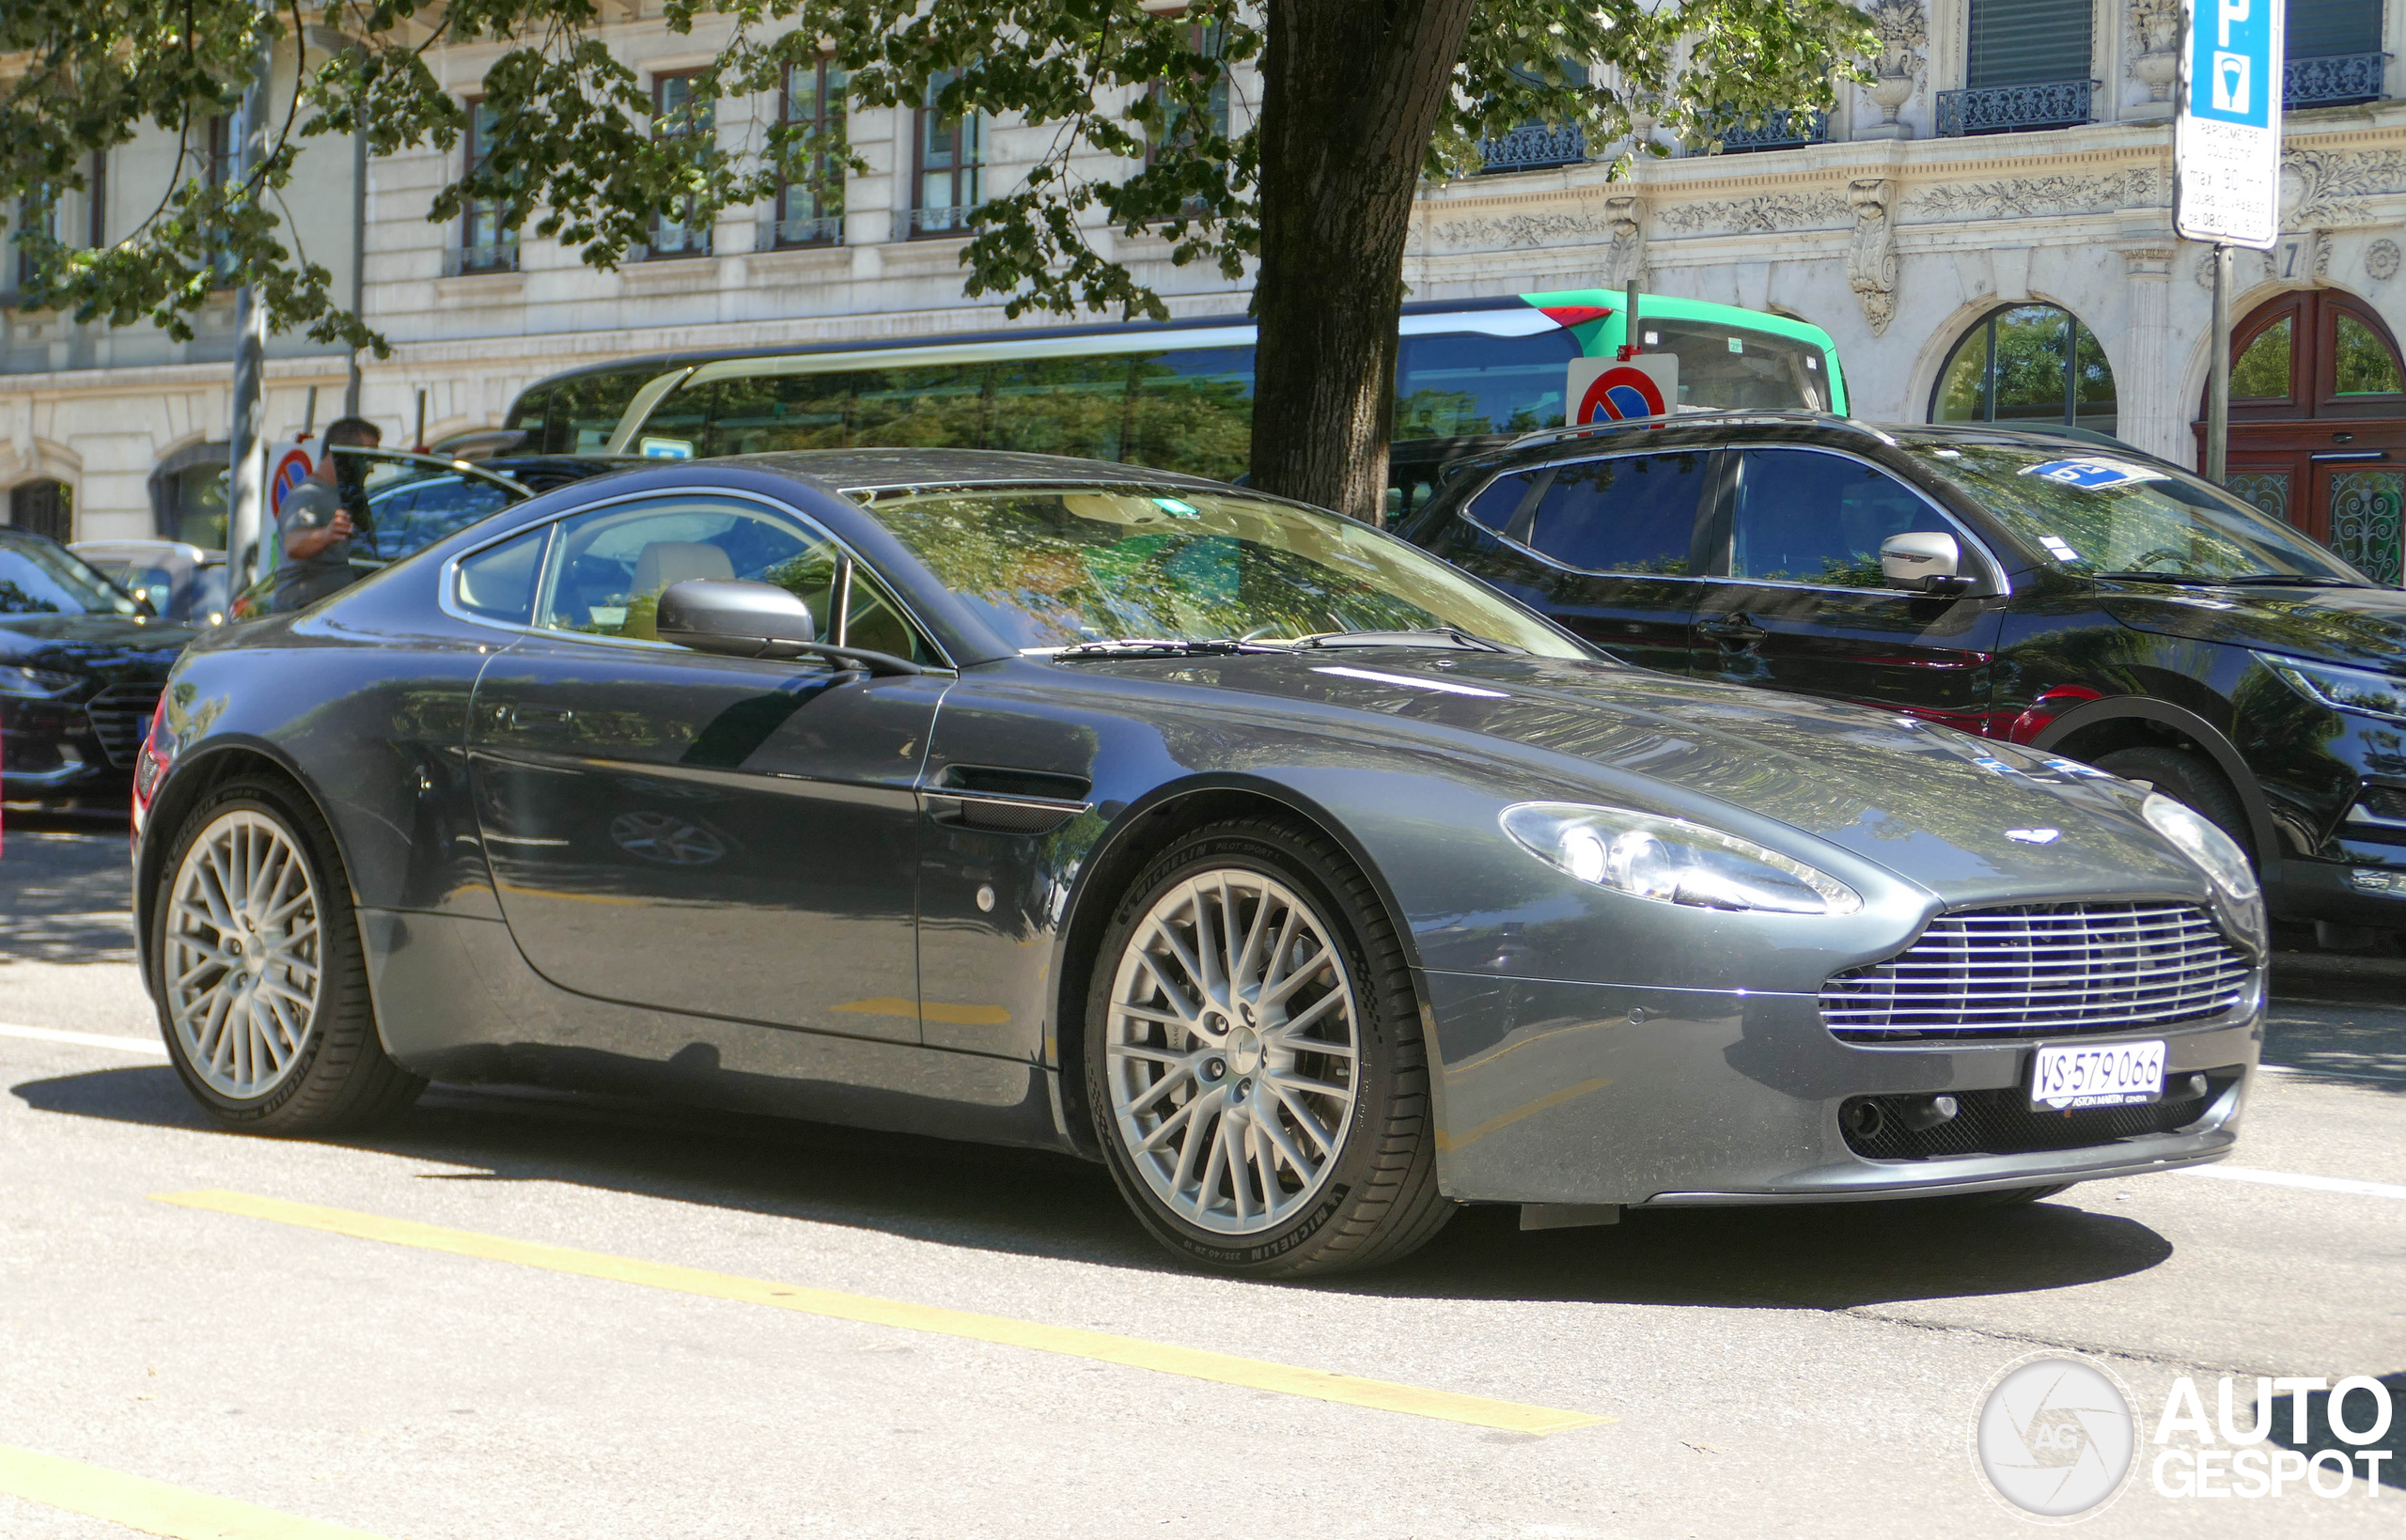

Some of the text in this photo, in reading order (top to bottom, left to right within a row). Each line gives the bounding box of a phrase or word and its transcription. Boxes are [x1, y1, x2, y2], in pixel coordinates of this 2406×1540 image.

[2218, 0, 2250, 47] P
[2207, 143, 2252, 162] COLLECTF
[2224, 167, 2239, 191] 90
[2190, 193, 2215, 207] JOURS
[1135, 843, 1207, 902] MICHELIN
[2072, 1096, 2096, 1107] ASTON
[2096, 1093, 2124, 1106] MARTIN
[1251, 1205, 1328, 1260] MICHELIN
[1208, 1250, 1242, 1261] 235/40
